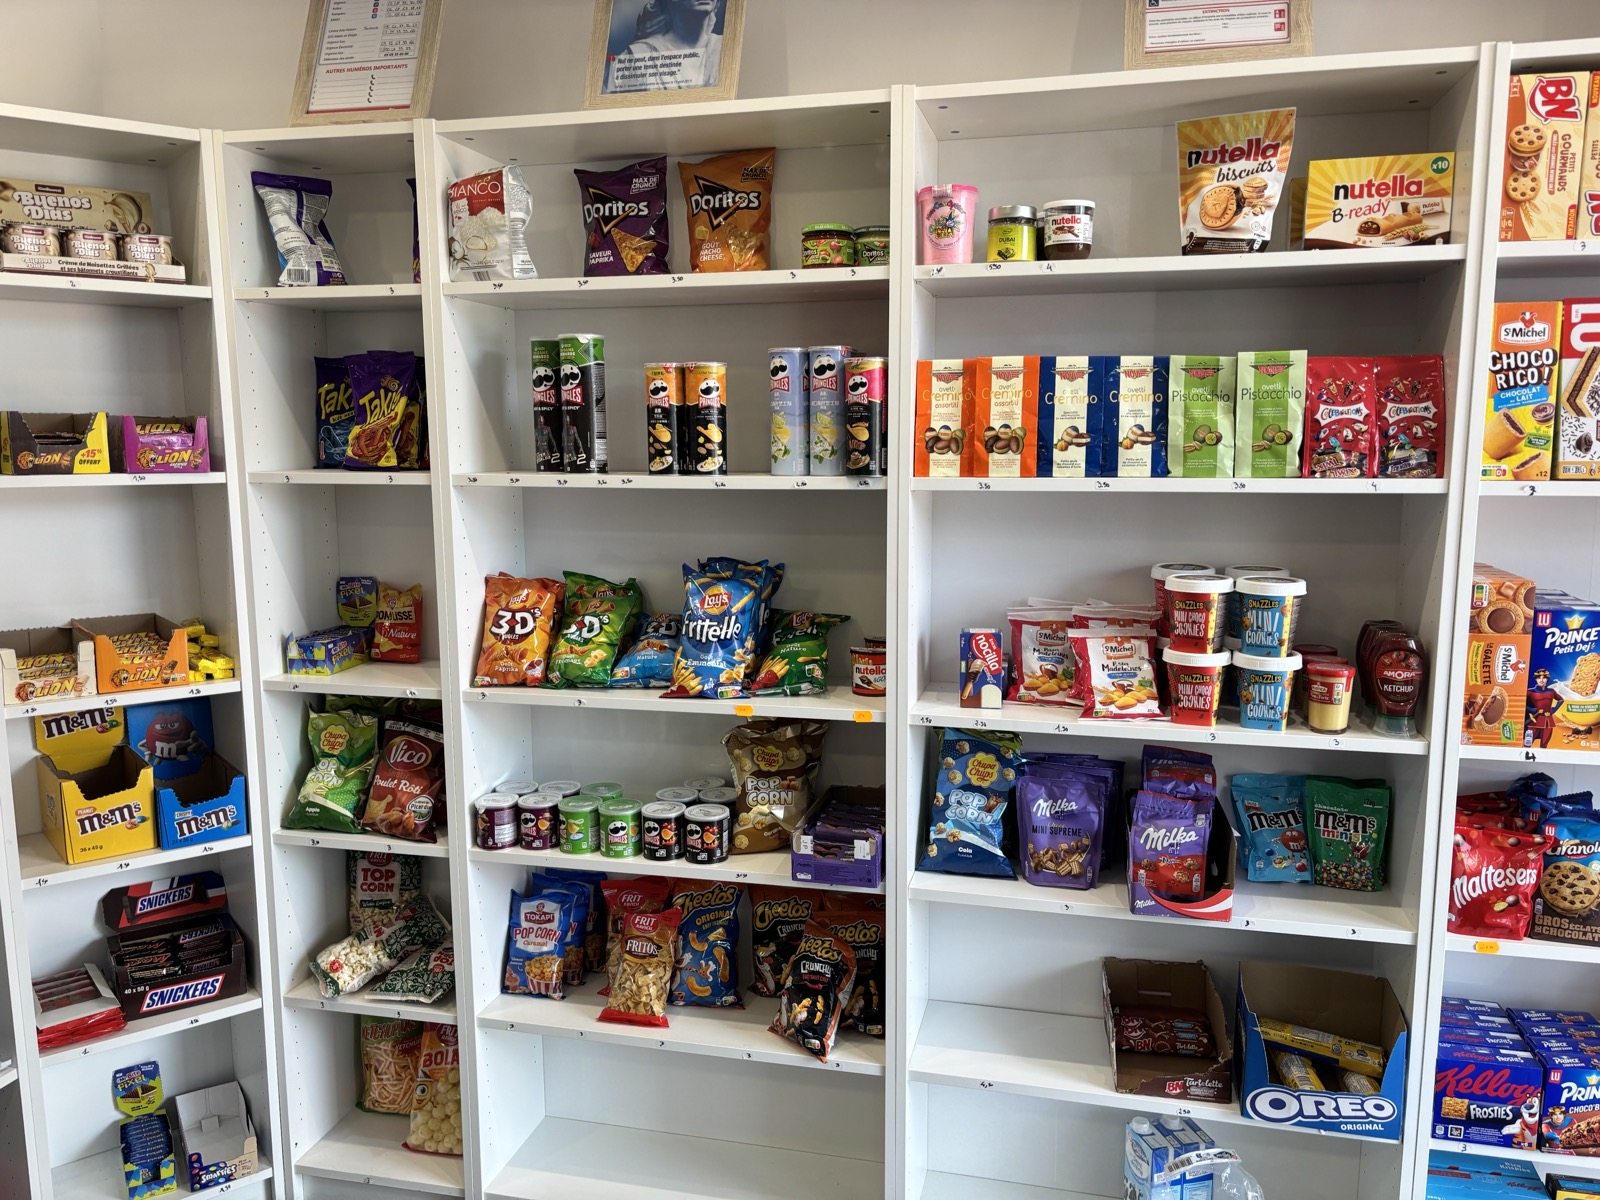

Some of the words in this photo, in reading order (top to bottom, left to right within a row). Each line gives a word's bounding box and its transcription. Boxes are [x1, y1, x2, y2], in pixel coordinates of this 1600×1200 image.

[648, 54, 660, 62] dans
[661, 53, 682, 61] l'espace
[660, 61, 682, 69] destinée
[620, 72, 647, 80] dissimuler
[1534, 77, 1581, 122] BN
[1188, 138, 1280, 168] nutella
[1432, 160, 1448, 170] x10
[1557, 134, 1572, 192] GOURMANDS
[1217, 160, 1276, 183] biscuits
[1334, 175, 1423, 200] nutella
[12, 191, 92, 210] Buenos
[691, 192, 760, 216] Doritos
[584, 201, 649, 224] Doritos
[1332, 200, 1391, 223] B-ready
[1052, 216, 1082, 225] nutella
[1567, 208, 1575, 236] NOUVEAU
[11, 235, 51, 246] Buenos
[72, 240, 110, 251] Buenos
[128, 244, 165, 254] Buenos
[589, 250, 612, 259] SAVEUR
[589, 256, 614, 264] PAPRIKA
[1490, 349, 1556, 371] CHOCO
[813, 378, 837, 390] PRINGLES
[1192, 385, 1210, 393] ovetti
[922, 390, 971, 401] Cremino
[982, 388, 1032, 400] Cremino
[1045, 393, 1097, 405] Cremino
[1109, 390, 1163, 403] Cremino
[1172, 390, 1230, 403] Pistacchio
[1241, 387, 1301, 401] Pistacchio
[1500, 386, 1541, 399] CHOCOLAT
[1516, 394, 1534, 402] LAIT
[700, 397, 721, 407] PRINGLES
[136, 424, 182, 434] LION
[340, 588, 365, 598] Pixel
[705, 593, 728, 609] Lay's
[1175, 600, 1204, 609] SNAZZLES
[1248, 600, 1280, 608] SNAZZLES
[1174, 610, 1187, 621] MINI
[1188, 611, 1206, 624] CHOCO
[1249, 610, 1279, 632] MINI
[1538, 614, 1550, 625] LU
[388, 628, 417, 639] Nature
[682, 610, 742, 644] Fritelle
[1174, 621, 1205, 636] COOKIES
[1246, 630, 1279, 645] COOKIES
[1545, 627, 1599, 648] PRINCE
[976, 634, 999, 671] nocilla
[494, 665, 519, 674] Paprika
[1482, 649, 1492, 685] GALETTE
[1180, 674, 1210, 683] SNAZZLES
[1250, 674, 1282, 683] SNAZZLES
[1383, 671, 1416, 679] AMORA
[36, 678, 77, 697] LION
[1178, 684, 1193, 694] MINI
[1195, 684, 1212, 696] CHOCO
[1250, 684, 1281, 705] MINI
[1178, 694, 1211, 709] COOKIES
[1247, 703, 1281, 718] COOKIES
[324, 732, 347, 740] Chupa
[322, 739, 344, 750] Chups
[390, 744, 426, 765] Vico
[757, 749, 779, 758] Chupa
[756, 756, 779, 767] Chups
[972, 759, 996, 769] Chupa
[969, 768, 994, 782] Chups
[374, 775, 398, 789] Poulet
[399, 779, 424, 794] Rôti
[746, 777, 780, 791] POP
[747, 791, 793, 806] CORN
[949, 790, 987, 807] POP
[1033, 799, 1078, 817] Milka
[77, 803, 142, 836] m&m's
[945, 805, 993, 825] CORN
[1314, 809, 1376, 834] m&m's
[175, 806, 236, 838] m&m's
[1032, 825, 1047, 834] MINI
[1049, 826, 1082, 837] SUPREME
[1546, 827, 1555, 836] LU
[608, 836, 628, 844] PRINGLES
[1141, 827, 1199, 850] Milka
[361, 868, 396, 881] TOP
[360, 883, 394, 893] CORN
[1453, 865, 1537, 909] Maltesers
[138, 886, 192, 912] SNICKERS
[622, 894, 643, 903] FRIT
[1135, 899, 1156, 908] Milka
[526, 913, 554, 921] TOKAPI
[755, 897, 810, 930] Cheetos
[634, 916, 657, 926] FRIT
[514, 927, 534, 940] POP
[534, 927, 561, 942] CORN
[626, 941, 658, 955] FRITOS
[801, 960, 832, 978] CRUNCHY
[146, 978, 221, 1009] SNICKERS
[1553, 1056, 1580, 1064] PRINCE
[117, 1075, 146, 1091] Pixel
[1184, 1077, 1223, 1088] Tartelette
[1551, 1072, 1560, 1081] LU
[1250, 1089, 1395, 1121] OREO
[1470, 1105, 1513, 1120] FROSTIES
[201, 1164, 237, 1183] SMARTIES
[1506, 1181, 1542, 1191] Kellogg's
